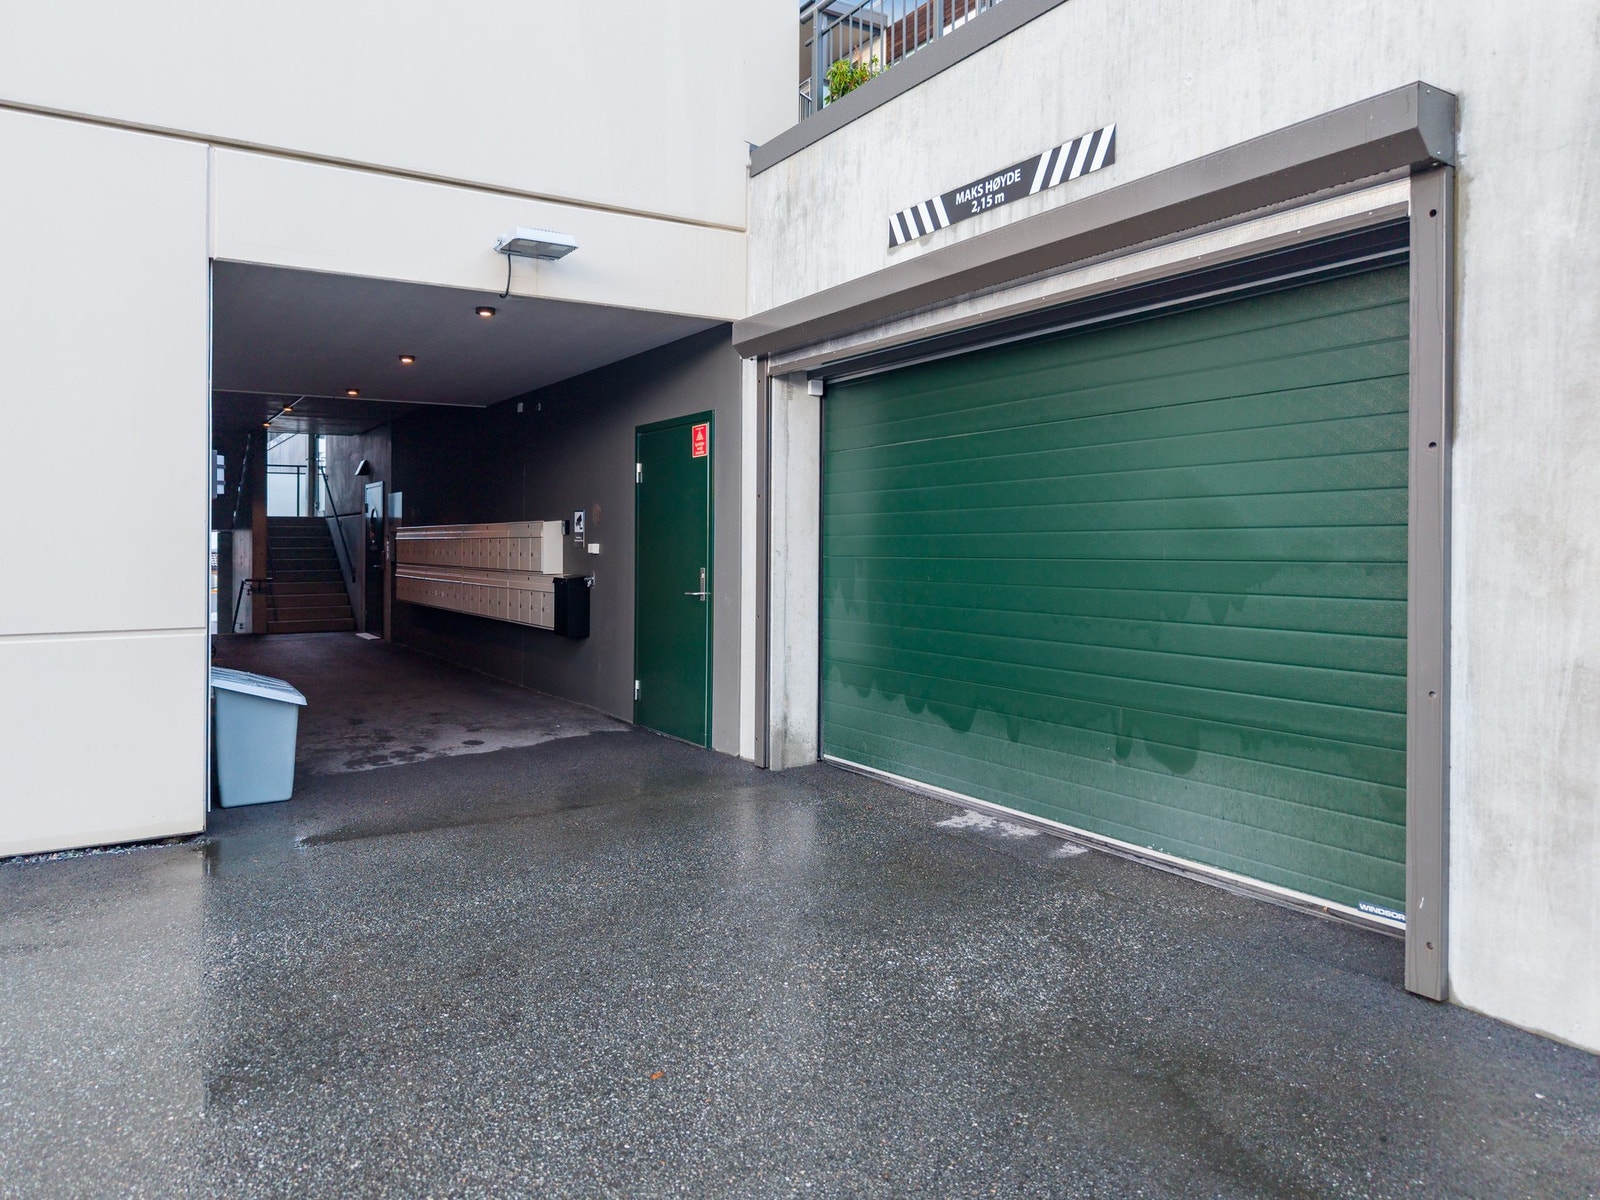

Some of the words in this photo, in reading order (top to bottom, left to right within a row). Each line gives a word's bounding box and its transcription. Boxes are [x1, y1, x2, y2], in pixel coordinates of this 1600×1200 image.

[955, 183, 984, 206] MAKS
[985, 168, 1021, 191] HØYDE
[971, 196, 993, 213] 2,15
[994, 192, 1005, 203] m
[1359, 903, 1406, 921] WINDSOR
